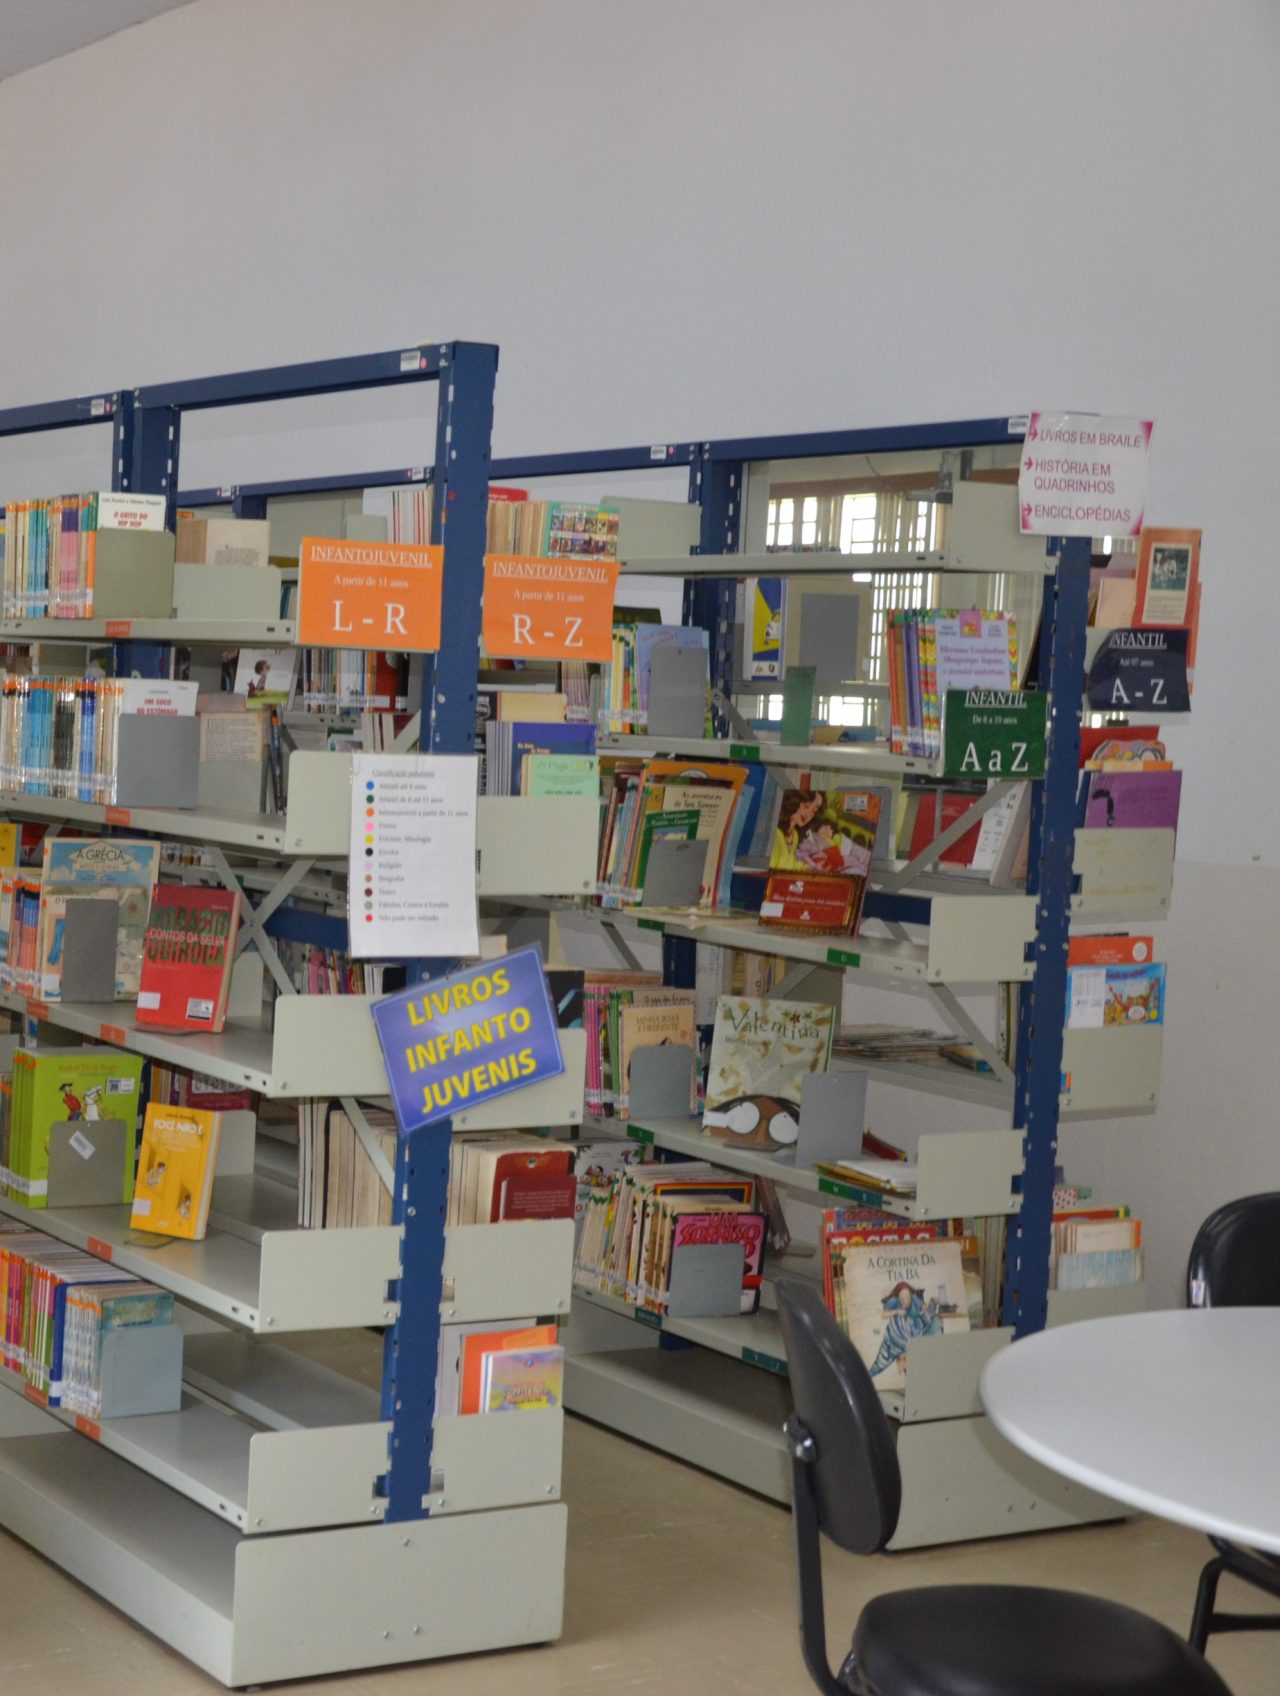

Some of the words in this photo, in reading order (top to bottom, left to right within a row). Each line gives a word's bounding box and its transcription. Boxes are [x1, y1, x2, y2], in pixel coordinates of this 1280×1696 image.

[1040, 430, 1077, 444] LIVROS
[1079, 432, 1096, 445] EM
[1099, 434, 1142, 448] BRAILE
[1035, 458, 1089, 475] HISTÓRIA
[1092, 463, 1111, 476] EM
[1034, 476, 1115, 494] QUADRINHOS
[1034, 504, 1131, 522] ENCICLOPÉDIAS
[311, 545, 432, 568] INFANTOJUVENIL
[493, 561, 608, 583] INFANTOJUVENIL
[334, 574, 341, 584] A
[342, 575, 366, 588] partir
[367, 576, 377, 587] de
[379, 577, 388, 587] 11
[390, 579, 408, 589] anos
[514, 589, 521, 599] A
[522, 590, 544, 602] partir
[546, 591, 555, 601] de
[557, 592, 565, 601] 11
[567, 594, 584, 603] anos
[333, 600, 352, 632] L
[385, 602, 407, 635] R
[512, 614, 535, 644] R
[564, 617, 583, 647] Z
[1109, 631, 1168, 649] INFANTIL
[964, 691, 1027, 708] INFANTIL
[1111, 678, 1130, 704] A
[1151, 679, 1167, 704] Z
[973, 715, 983, 724] De
[960, 742, 982, 771] A
[988, 750, 1002, 771] a
[1011, 742, 1029, 772] Z
[76, 848, 84, 859] A
[86, 846, 125, 861] GRÉCIA
[407, 968, 511, 1027] LIVROS
[728, 1006, 820, 1041] Valentina
[405, 1007, 531, 1073] INFANTO
[422, 1048, 537, 1114] JUVENIS
[867, 1258, 876, 1269] A
[876, 1256, 919, 1268] CORTINA
[887, 1270, 903, 1281] TIA
